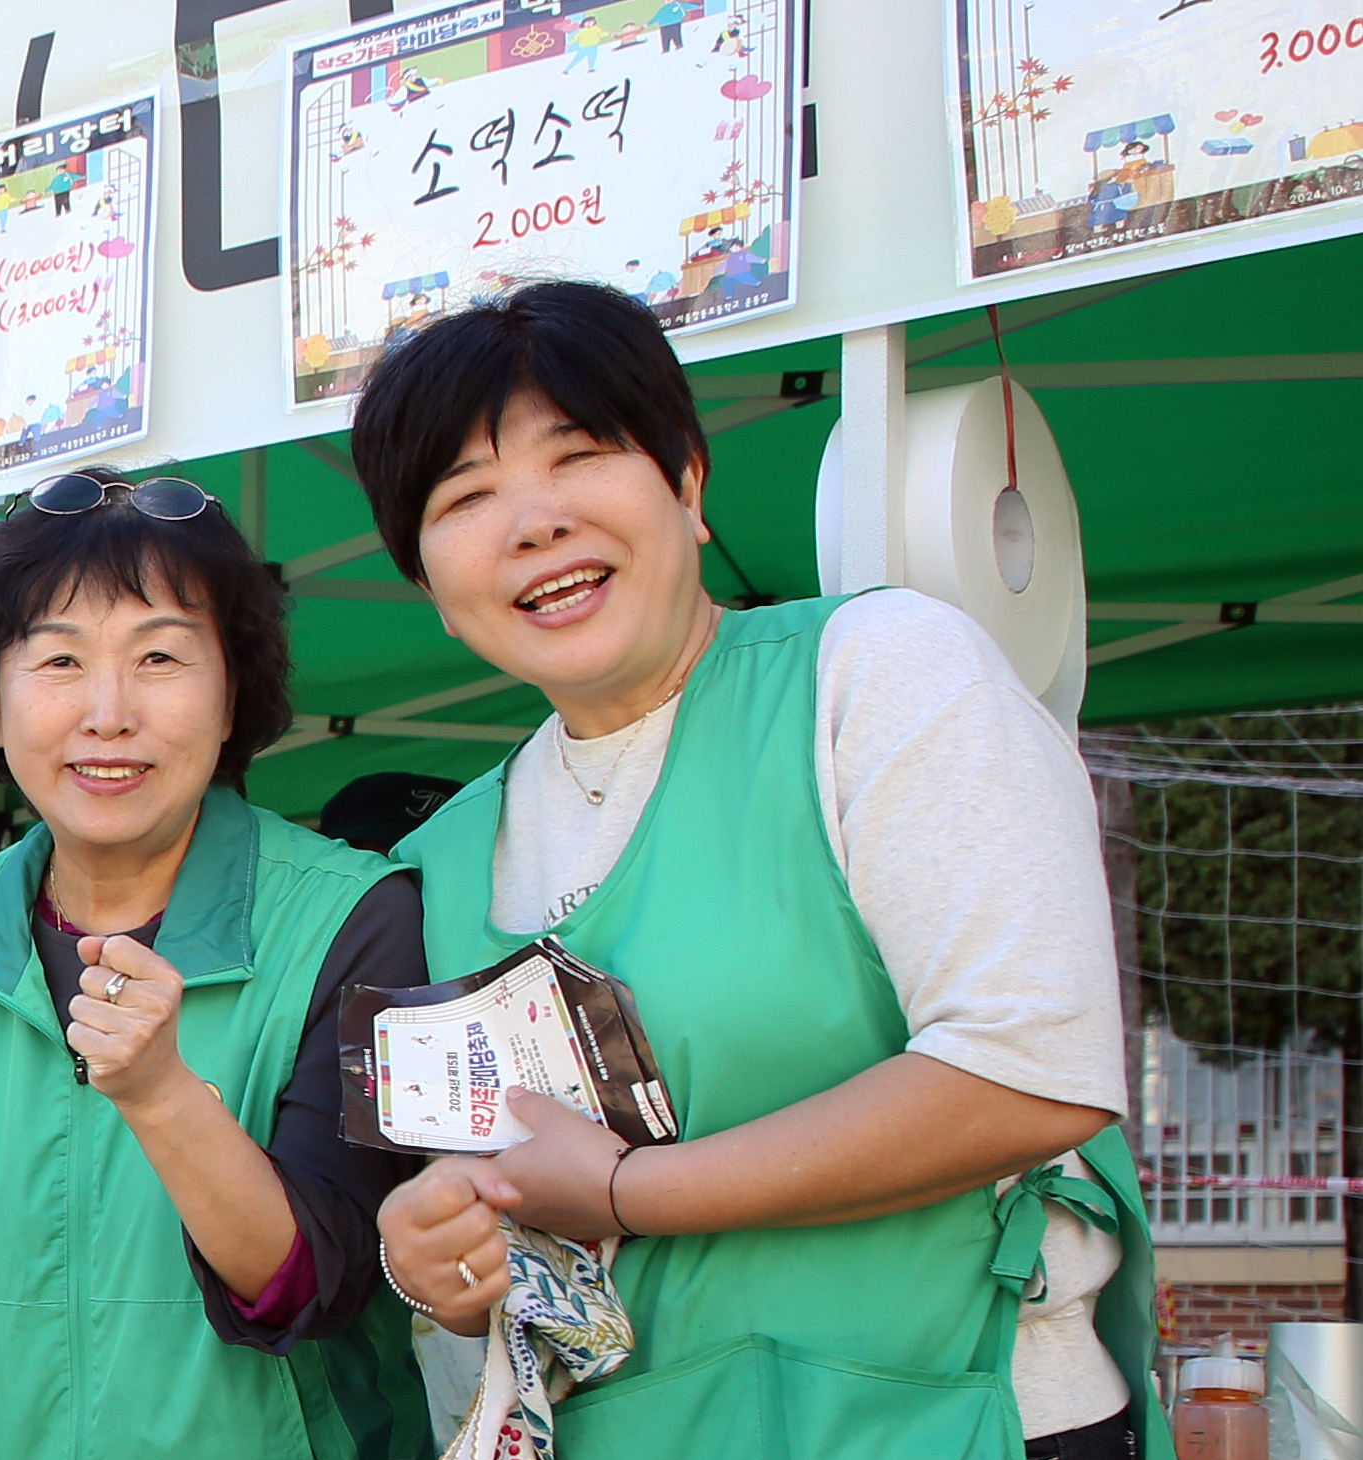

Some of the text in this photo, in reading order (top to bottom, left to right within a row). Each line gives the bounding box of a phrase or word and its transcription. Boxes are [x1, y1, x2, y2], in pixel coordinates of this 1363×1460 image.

[411, 77, 631, 206] 소떡소떡
[472, 184, 606, 249] 2.000원
[448, 1080, 462, 1113] 2024년
[466, 1021, 501, 1139] 창오가족한마당축제
